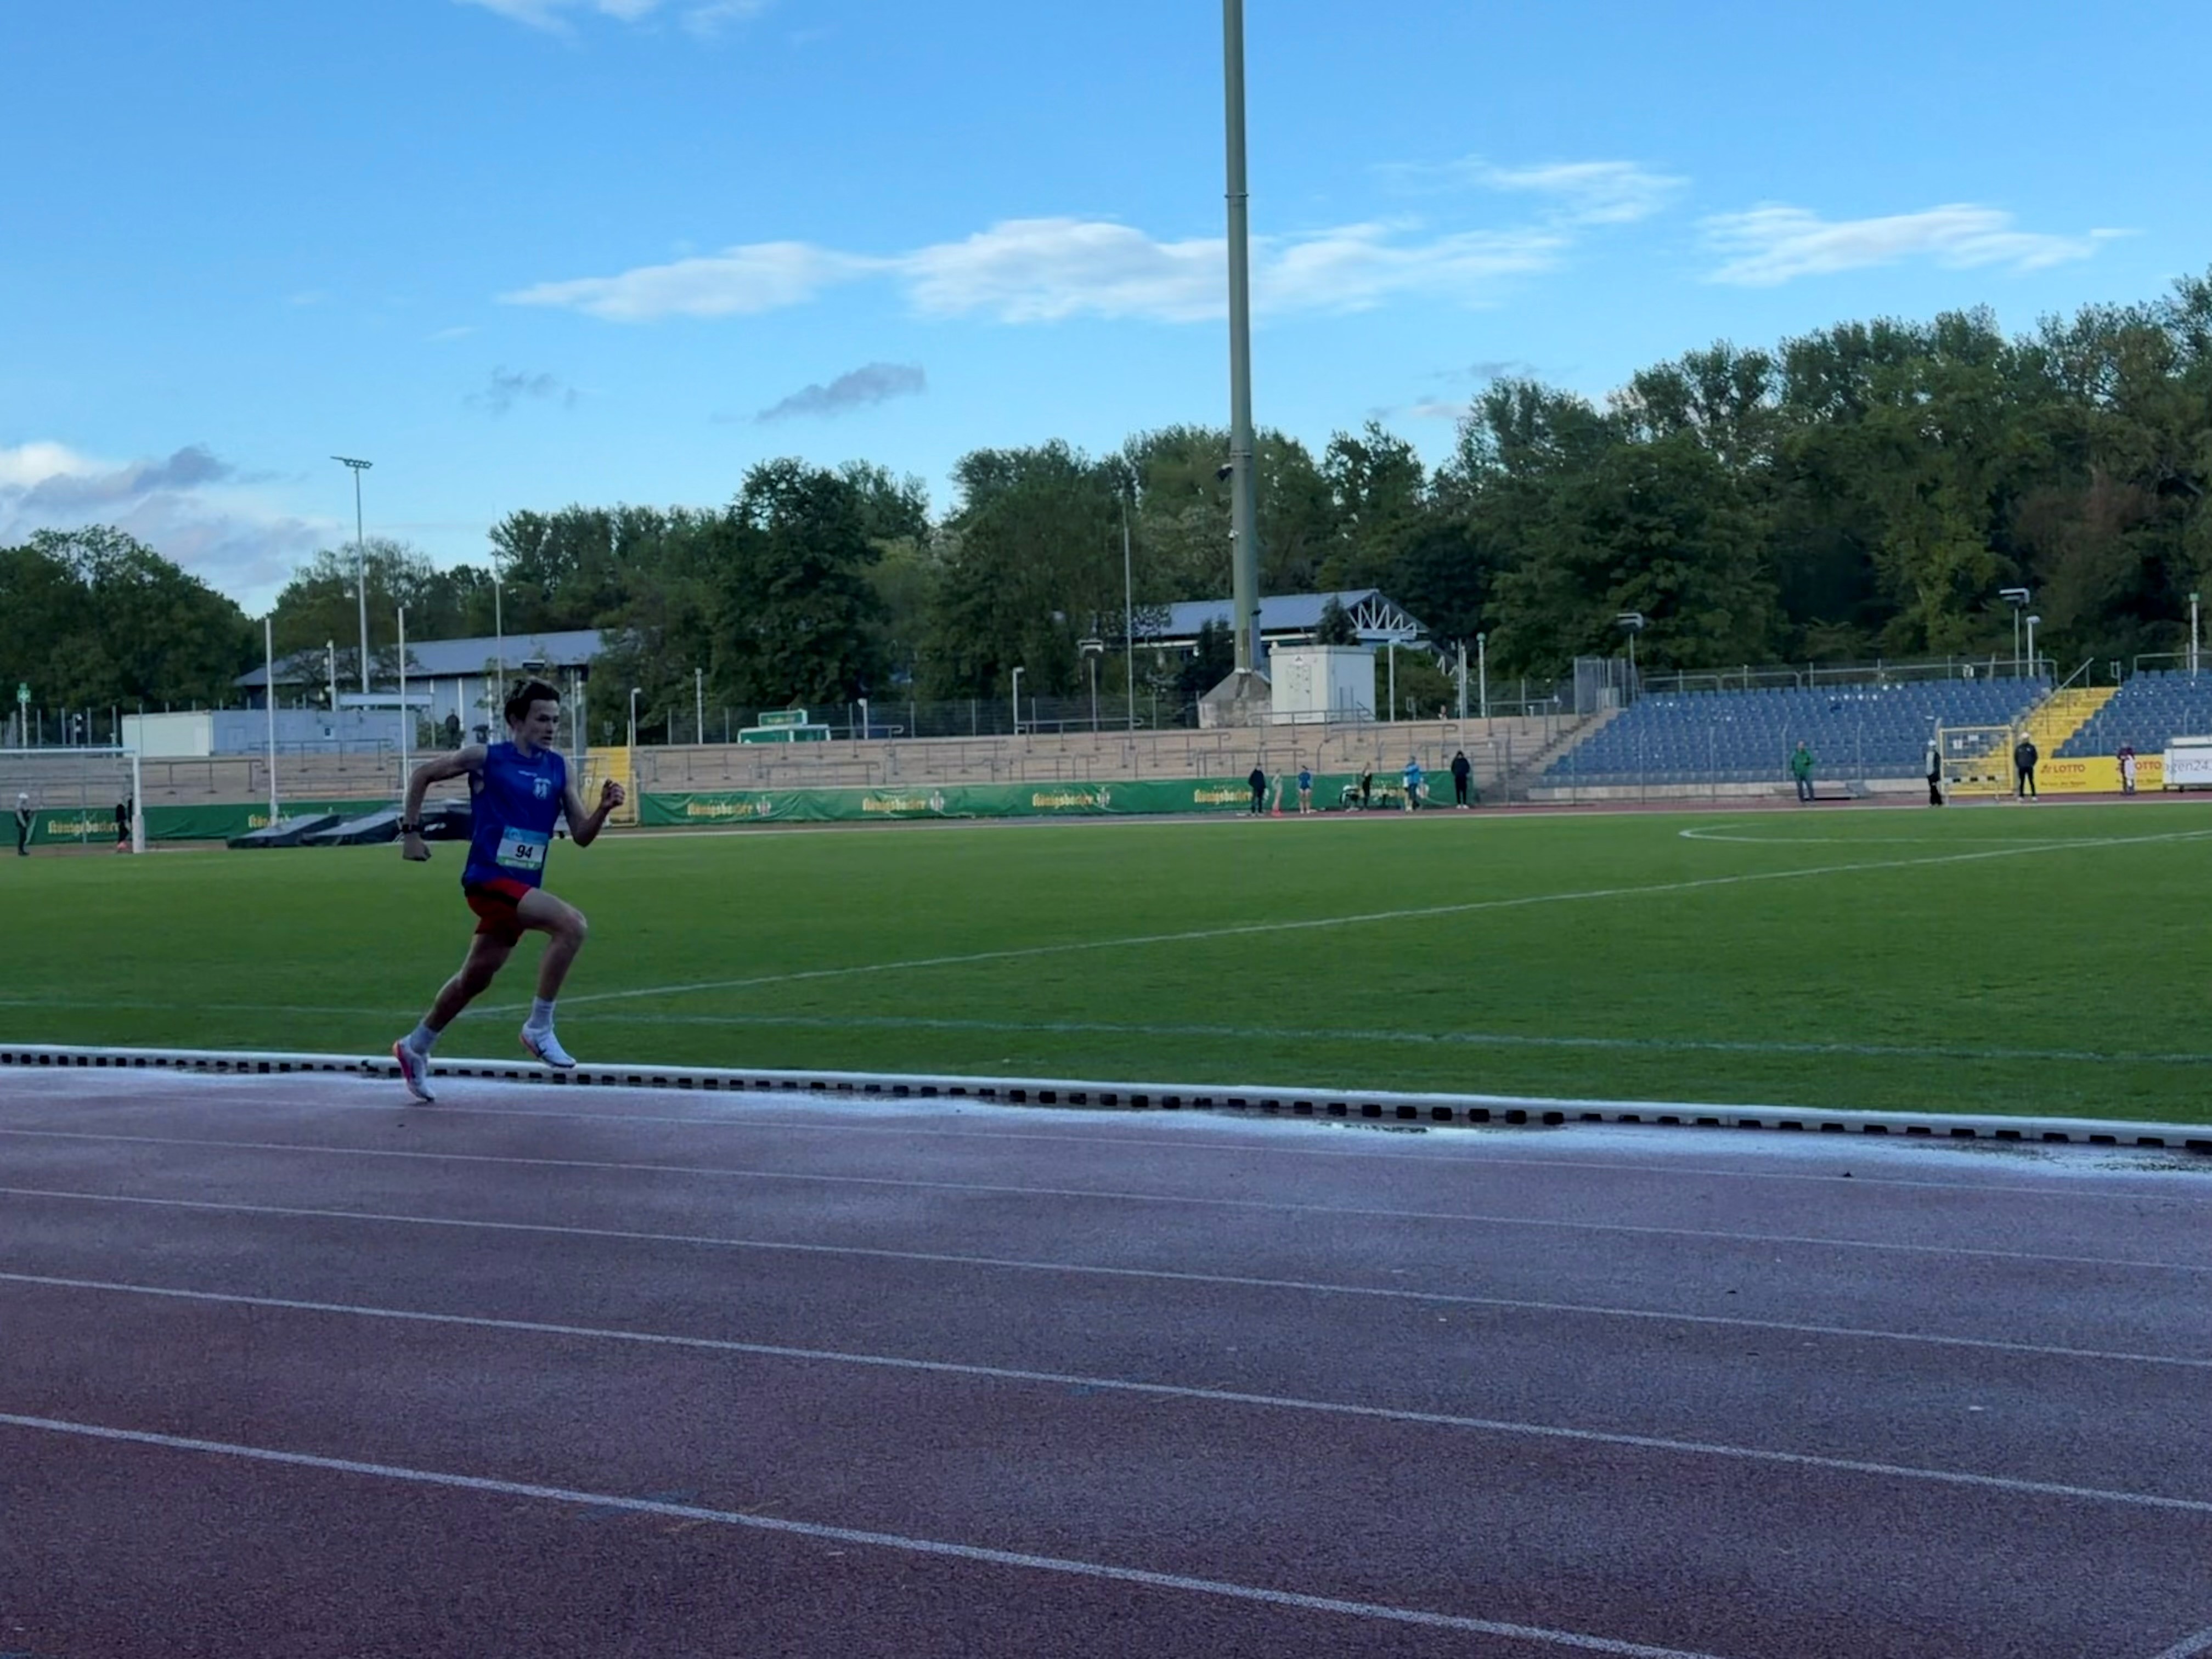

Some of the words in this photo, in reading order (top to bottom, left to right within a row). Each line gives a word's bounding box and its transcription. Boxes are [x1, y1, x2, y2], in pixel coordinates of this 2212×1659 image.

[2053, 764, 2086, 774] LOTTO
[2134, 761, 2162, 771] OTTO
[516, 844, 533, 859] 94
